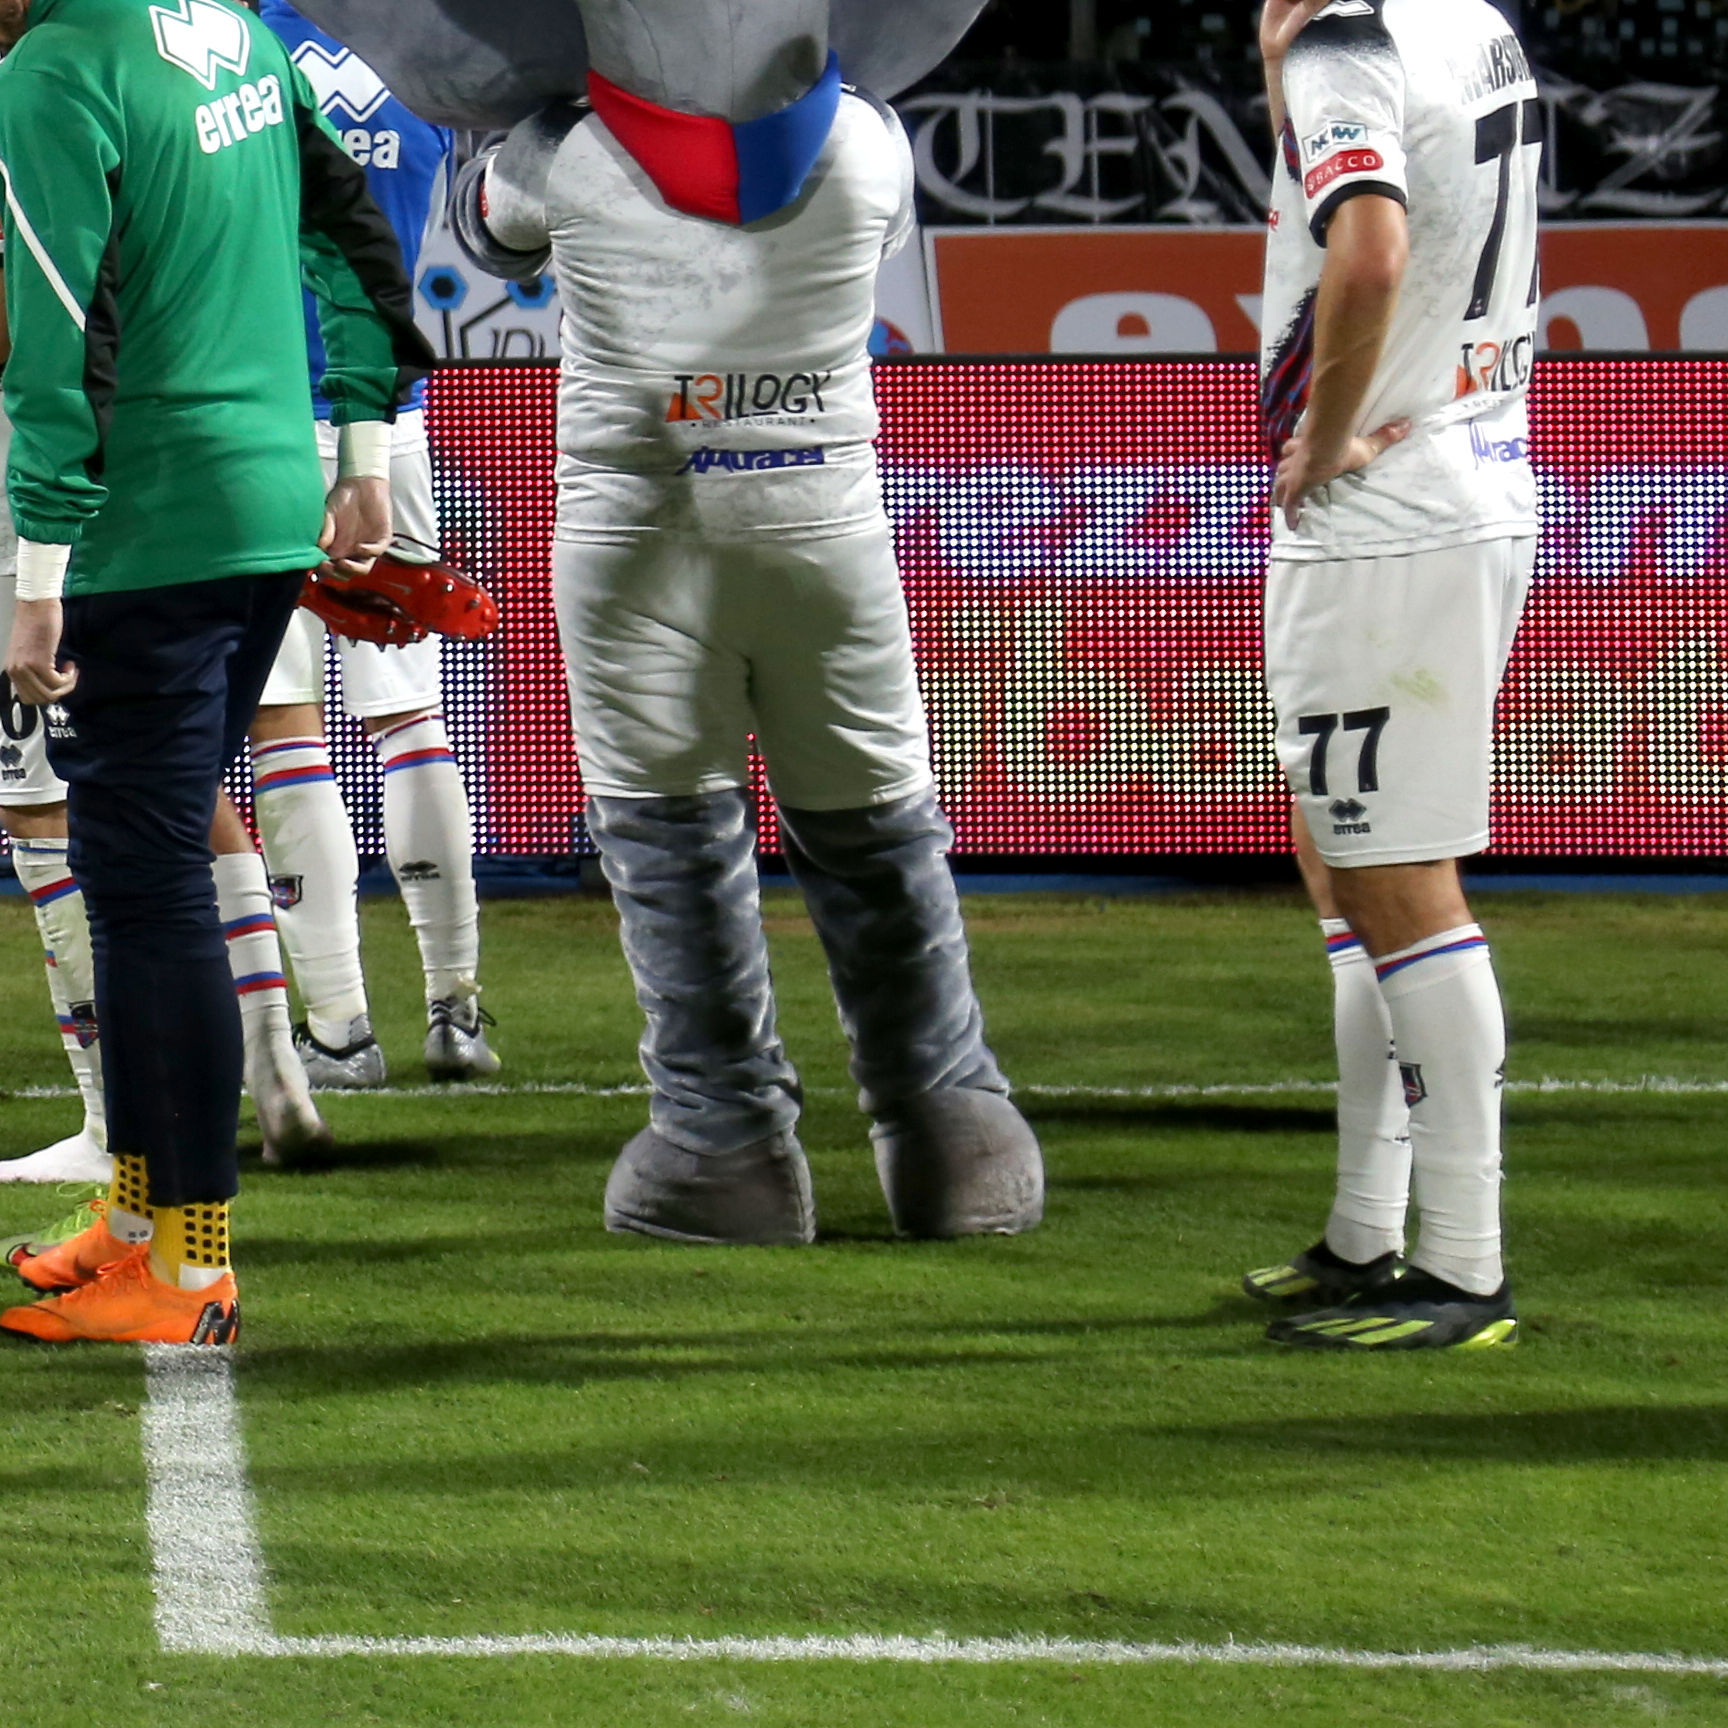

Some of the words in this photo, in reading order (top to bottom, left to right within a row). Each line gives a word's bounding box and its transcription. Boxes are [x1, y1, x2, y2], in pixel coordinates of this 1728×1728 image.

[195, 74, 284, 154] errea
[1464, 97, 1542, 320] 77
[666, 369, 831, 422] TRILOGY
[1298, 705, 1390, 795] 77
